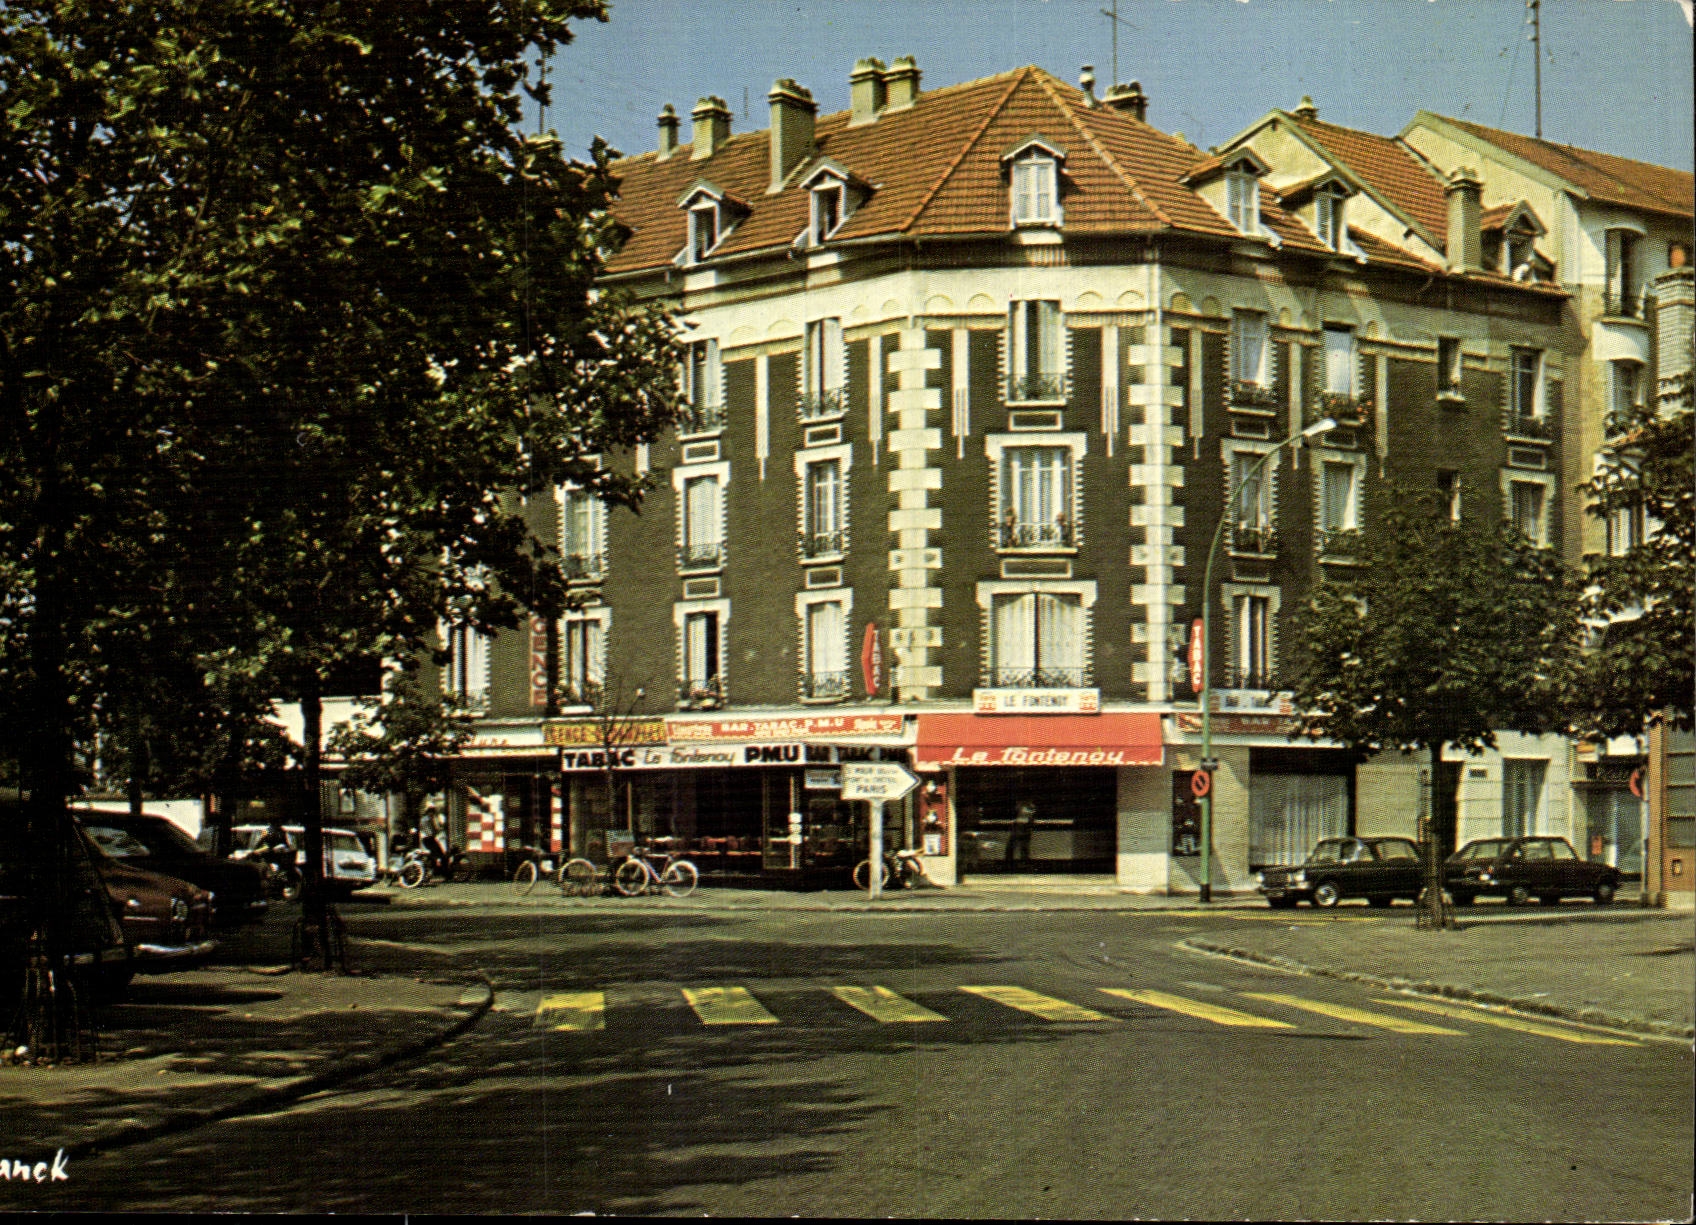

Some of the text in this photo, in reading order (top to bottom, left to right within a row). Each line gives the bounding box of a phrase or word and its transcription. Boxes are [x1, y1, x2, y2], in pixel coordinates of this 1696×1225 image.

[1003, 695, 1016, 707] LE
[562, 750, 635, 768] TABAC
[744, 745, 800, 763] PMU
[952, 747, 988, 762] Le
